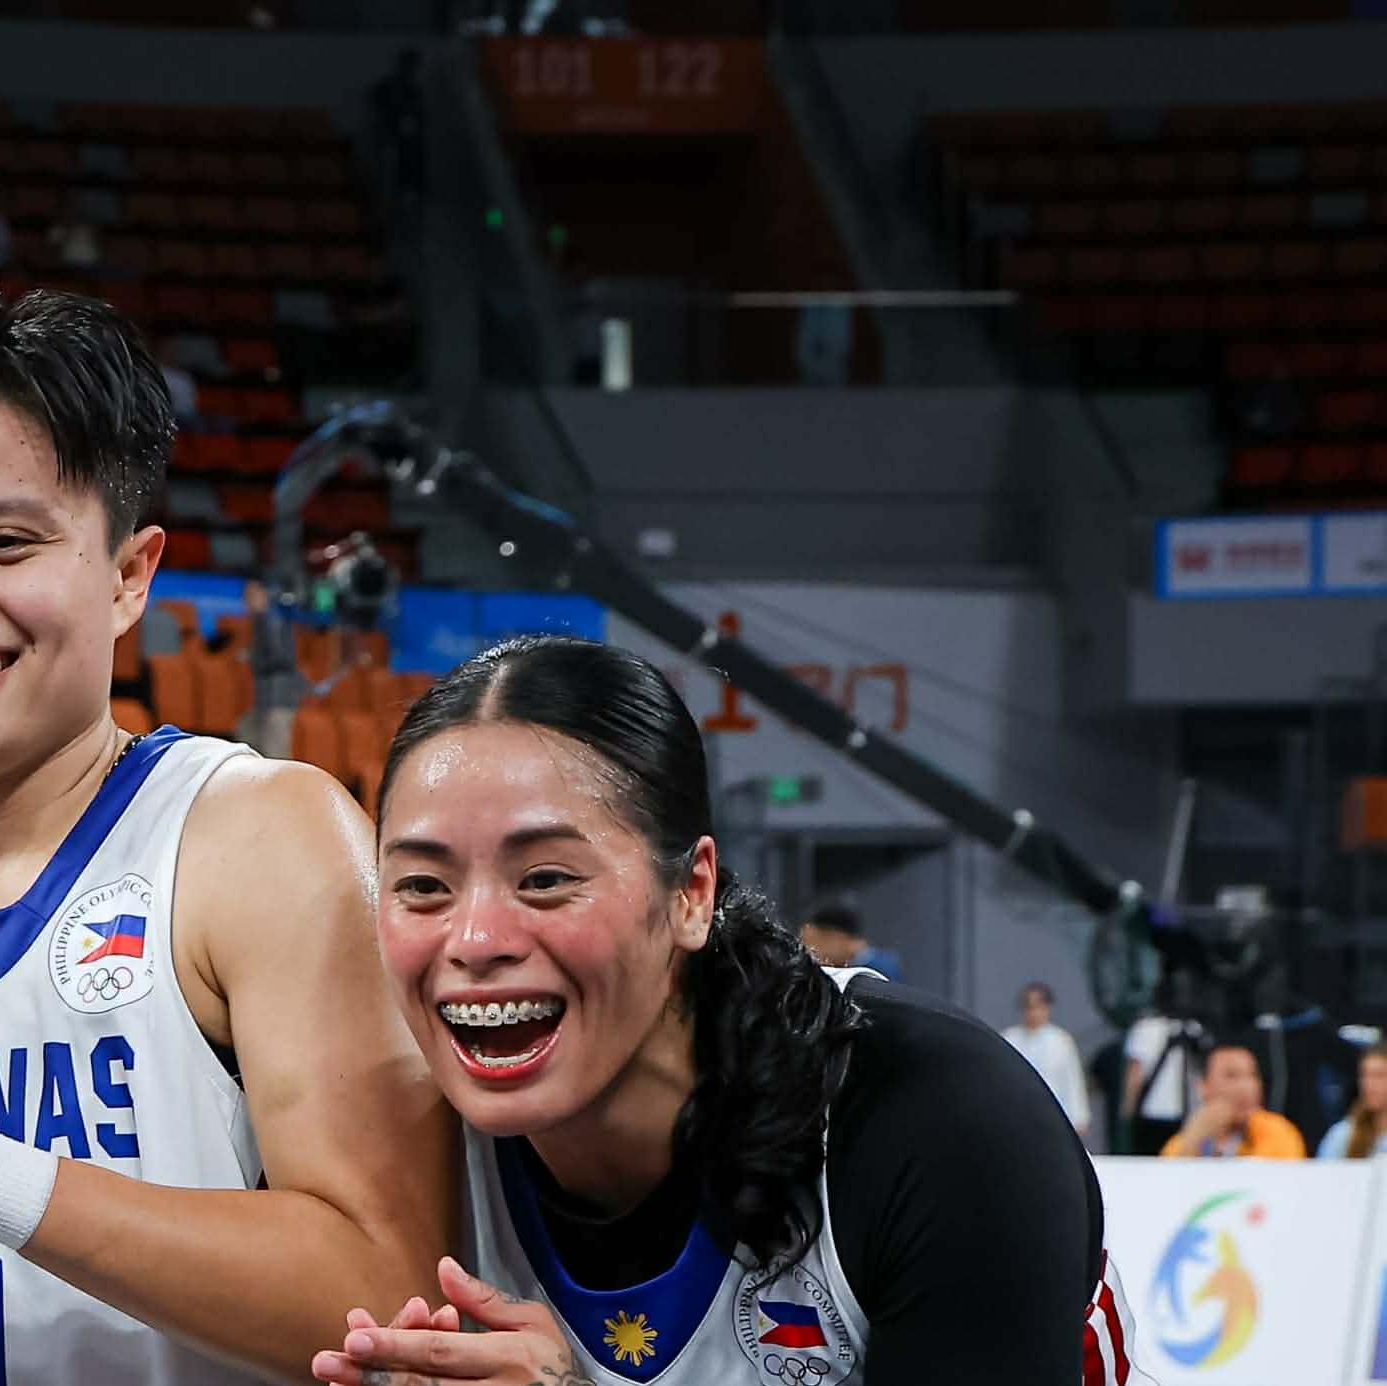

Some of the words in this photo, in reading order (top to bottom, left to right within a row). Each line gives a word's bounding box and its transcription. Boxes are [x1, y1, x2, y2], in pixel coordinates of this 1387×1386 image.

[512, 45, 594, 96] 101
[636, 43, 722, 96] 122
[54, 904, 89, 985] PHILIPPINE
